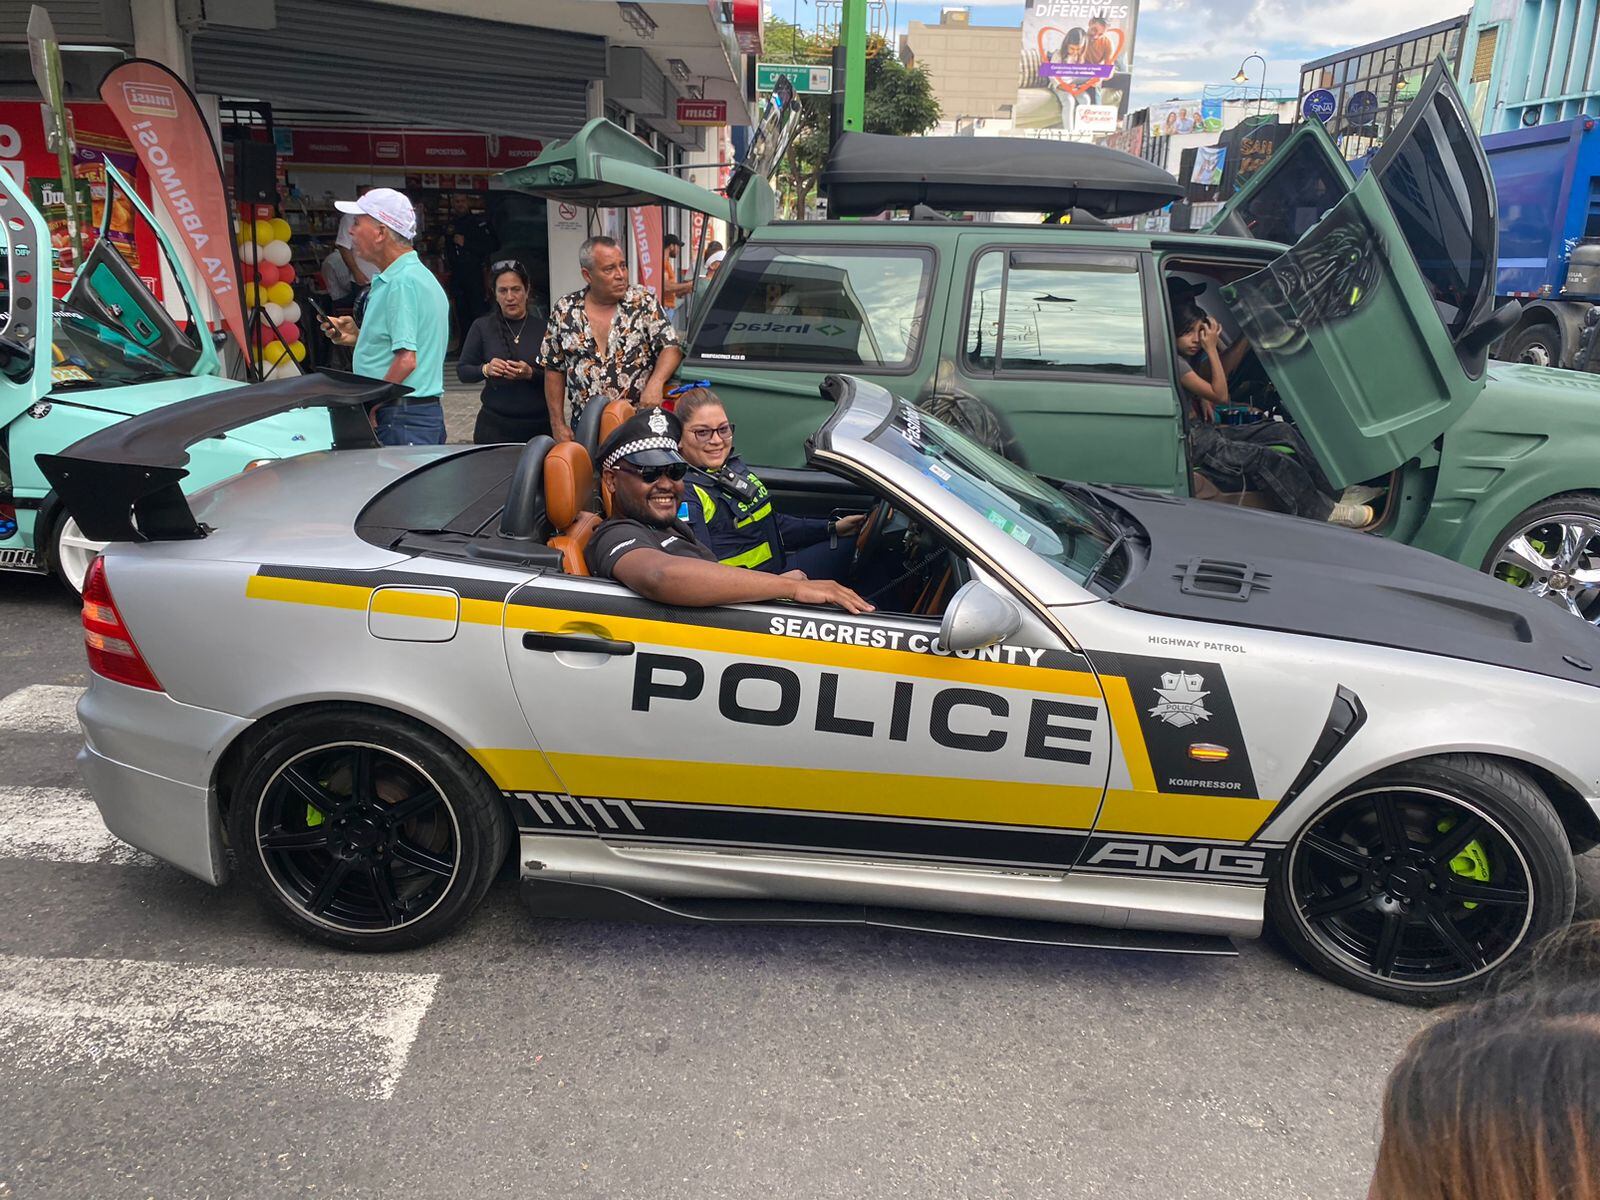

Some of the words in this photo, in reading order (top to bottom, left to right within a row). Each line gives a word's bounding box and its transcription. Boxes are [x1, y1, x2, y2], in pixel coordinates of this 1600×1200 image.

[1035, 4, 1129, 19] DIFERENTES
[769, 72, 792, 83] CAE
[792, 74, 798, 83] 7
[685, 107, 718, 119] musi
[42, 190, 83, 206] DUL
[770, 616, 905, 649] SEACREST
[1148, 635, 1200, 649] HIGHWAY
[1203, 641, 1247, 654] PATROL
[631, 651, 1100, 767] POLICE
[1166, 704, 1194, 712] POLICE
[1168, 778, 1242, 790] KOMPRESSOR
[1086, 841, 1267, 876] AMG
